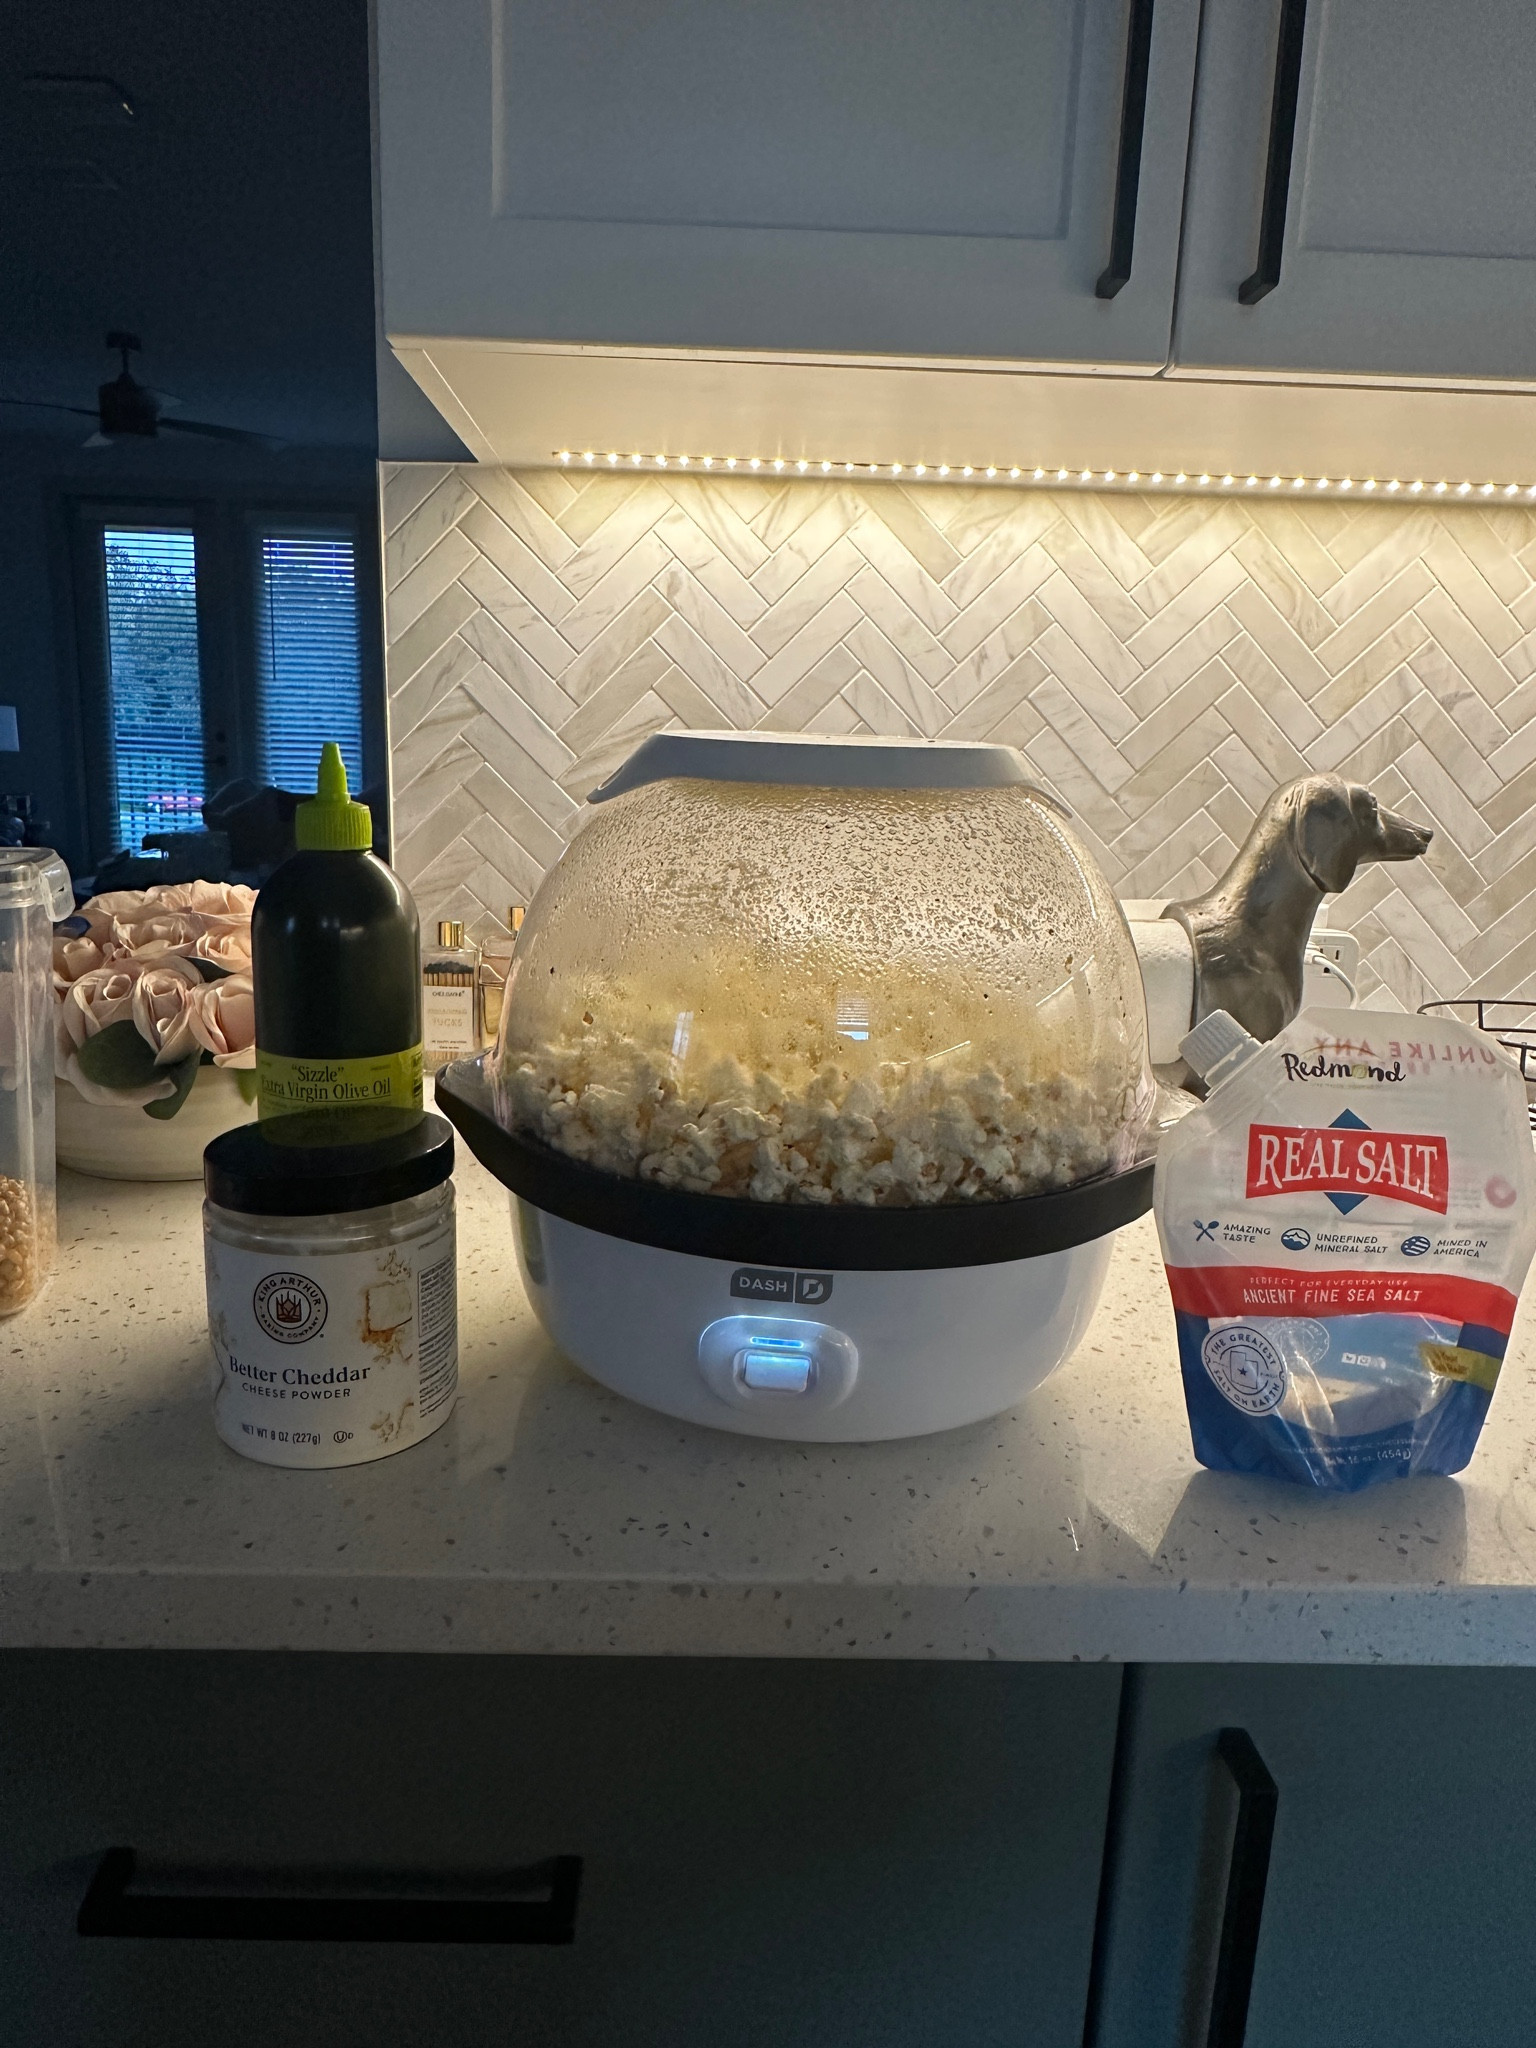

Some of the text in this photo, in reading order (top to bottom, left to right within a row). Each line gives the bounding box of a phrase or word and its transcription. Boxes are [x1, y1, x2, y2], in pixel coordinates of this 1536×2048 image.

[1281, 1053, 1406, 1082] Redmond
[261, 1075, 391, 1103] Extra Virgin Olive Oil
[1255, 1133, 1438, 1200] REAL SALT
[1222, 1233, 1256, 1244] TASTE
[1223, 1223, 1271, 1236] AMAZING
[1316, 1233, 1379, 1245] UNREFINED
[1437, 1239, 1489, 1249] MINED IN
[1314, 1244, 1389, 1254] MINERAL SALT
[1433, 1248, 1481, 1258] AMERICA
[739, 1276, 787, 1292] DASH
[1250, 1277, 1296, 1287] PERFECT
[258, 1277, 322, 1306] KING ARTHUR
[1243, 1288, 1423, 1304] ANCIENT FINE SEA SALT
[287, 1316, 319, 1338] COMPANY
[1211, 1338, 1227, 1355] THE
[1229, 1333, 1276, 1365] GREATEST
[229, 1355, 370, 1385] Better Cheddar
[242, 1382, 351, 1400] CHEESE POWDER
[1213, 1369, 1280, 1408] SALT ON EARTH
[242, 1422, 321, 1445] NET WT 8 OZ (227g)
